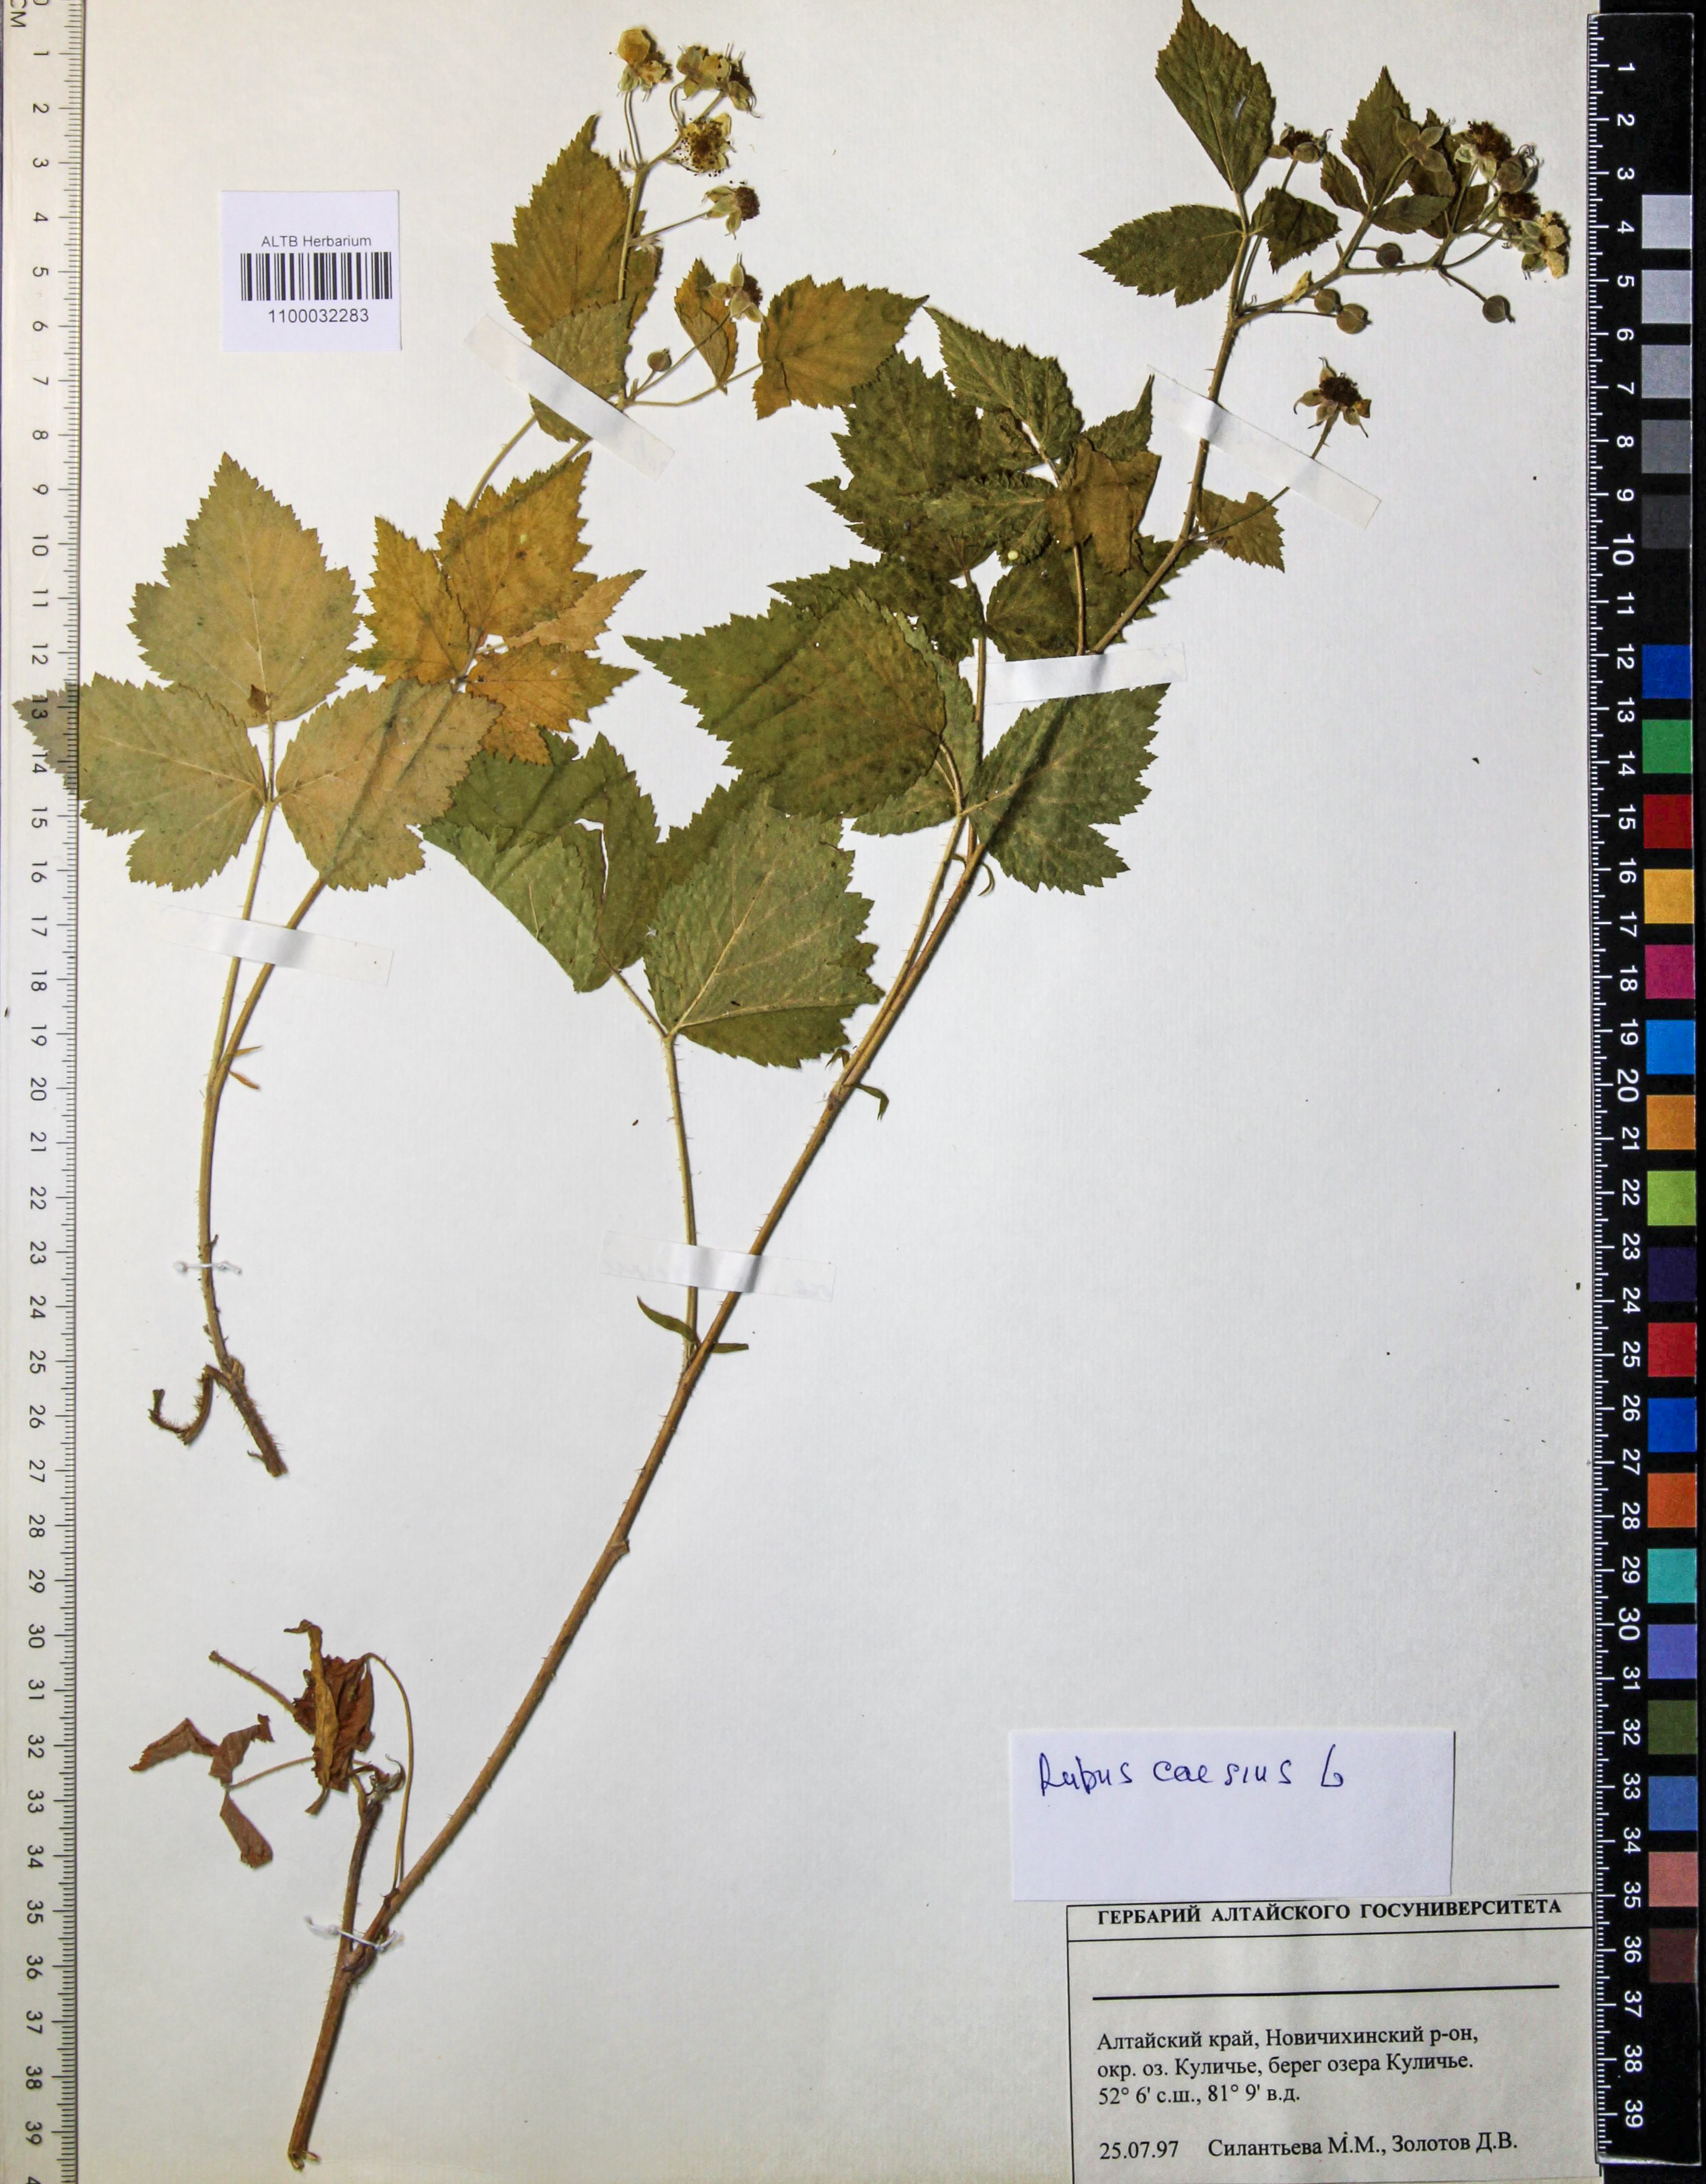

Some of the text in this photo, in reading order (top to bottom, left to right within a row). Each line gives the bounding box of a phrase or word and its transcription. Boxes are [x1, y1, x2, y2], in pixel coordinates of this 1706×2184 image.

[10, 0, 27, 28] CM
[33, 103, 50, 114] 2
[32, 158, 49, 168] 3
[33, 212, 49, 223] 4
[261, 235, 372, 248] ALTB Herbarium
[32, 266, 49, 277] 5
[32, 320, 48, 332] 6
[268, 308, 369, 323] 1100032283
[33, 377, 49, 385] 7
[32, 429, 49, 440] 8
[32, 484, 49, 495] 9
[32, 534, 49, 557] 10
[32, 589, 49, 607] 11
[32, 643, 49, 665] 12
[31, 697, 48, 720] 13
[31, 752, 48, 774] 14
[31, 807, 48, 829] 15
[31, 860, 48, 883] 16
[31, 915, 47, 937] 17
[31, 970, 47, 992] 18
[31, 1024, 47, 1046] 19
[30, 1077, 47, 1101] 20
[1614, 63, 1643, 2128] 1 2 3 4 5 6 7 8 9 10 11 12 13 14 15 16 17 18 19 20 21 22 23 24 25 26 27 28 29 30 31 32 33 34 35 36 37 38 39
[30, 1131, 47, 1152] 21
[30, 1186, 47, 1210] 22
[30, 1241, 47, 1265] 23
[30, 1295, 46, 1319] 24
[29, 1350, 46, 1374] 25
[29, 1405, 46, 1429] 26
[29, 1459, 45, 1483] 27
[29, 1514, 45, 1539] 28
[28, 1569, 45, 1593] 29
[28, 1624, 45, 1649] 30
[28, 1679, 45, 1700] 31
[28, 1734, 45, 1758] 32
[1039, 1753, 1133, 1797] Rubus
[27, 1789, 44, 1814] 33
[27, 1844, 44, 1869] 34
[26, 1899, 44, 1925] 35
[1098, 1899, 1562, 1925] ГЕРБАРИЙ АЛТАЙСКОГО ГОСУНИВЕРСИТЕТА
[26, 1955, 44, 1980] 36
[26, 2010, 44, 2034] 37
[1097, 2026, 1478, 2052] Алтайский край, Новичихинский р-он,
[25, 2065, 43, 2091] 38
[1097, 2053, 1473, 2082] окр. оз. Куличье, берег озера Куличье.
[1099, 2087, 1129, 2105] 52°
[1156, 2091, 1201, 2105] с.ш.,
[1208, 2084, 1238, 2102] 81°
[1268, 2088, 1300, 2103] в.д.
[25, 2121, 43, 2146] 39
[1099, 2131, 1517, 2160] 25.07.97 Силантьева М.М., Золотов Д.В.
